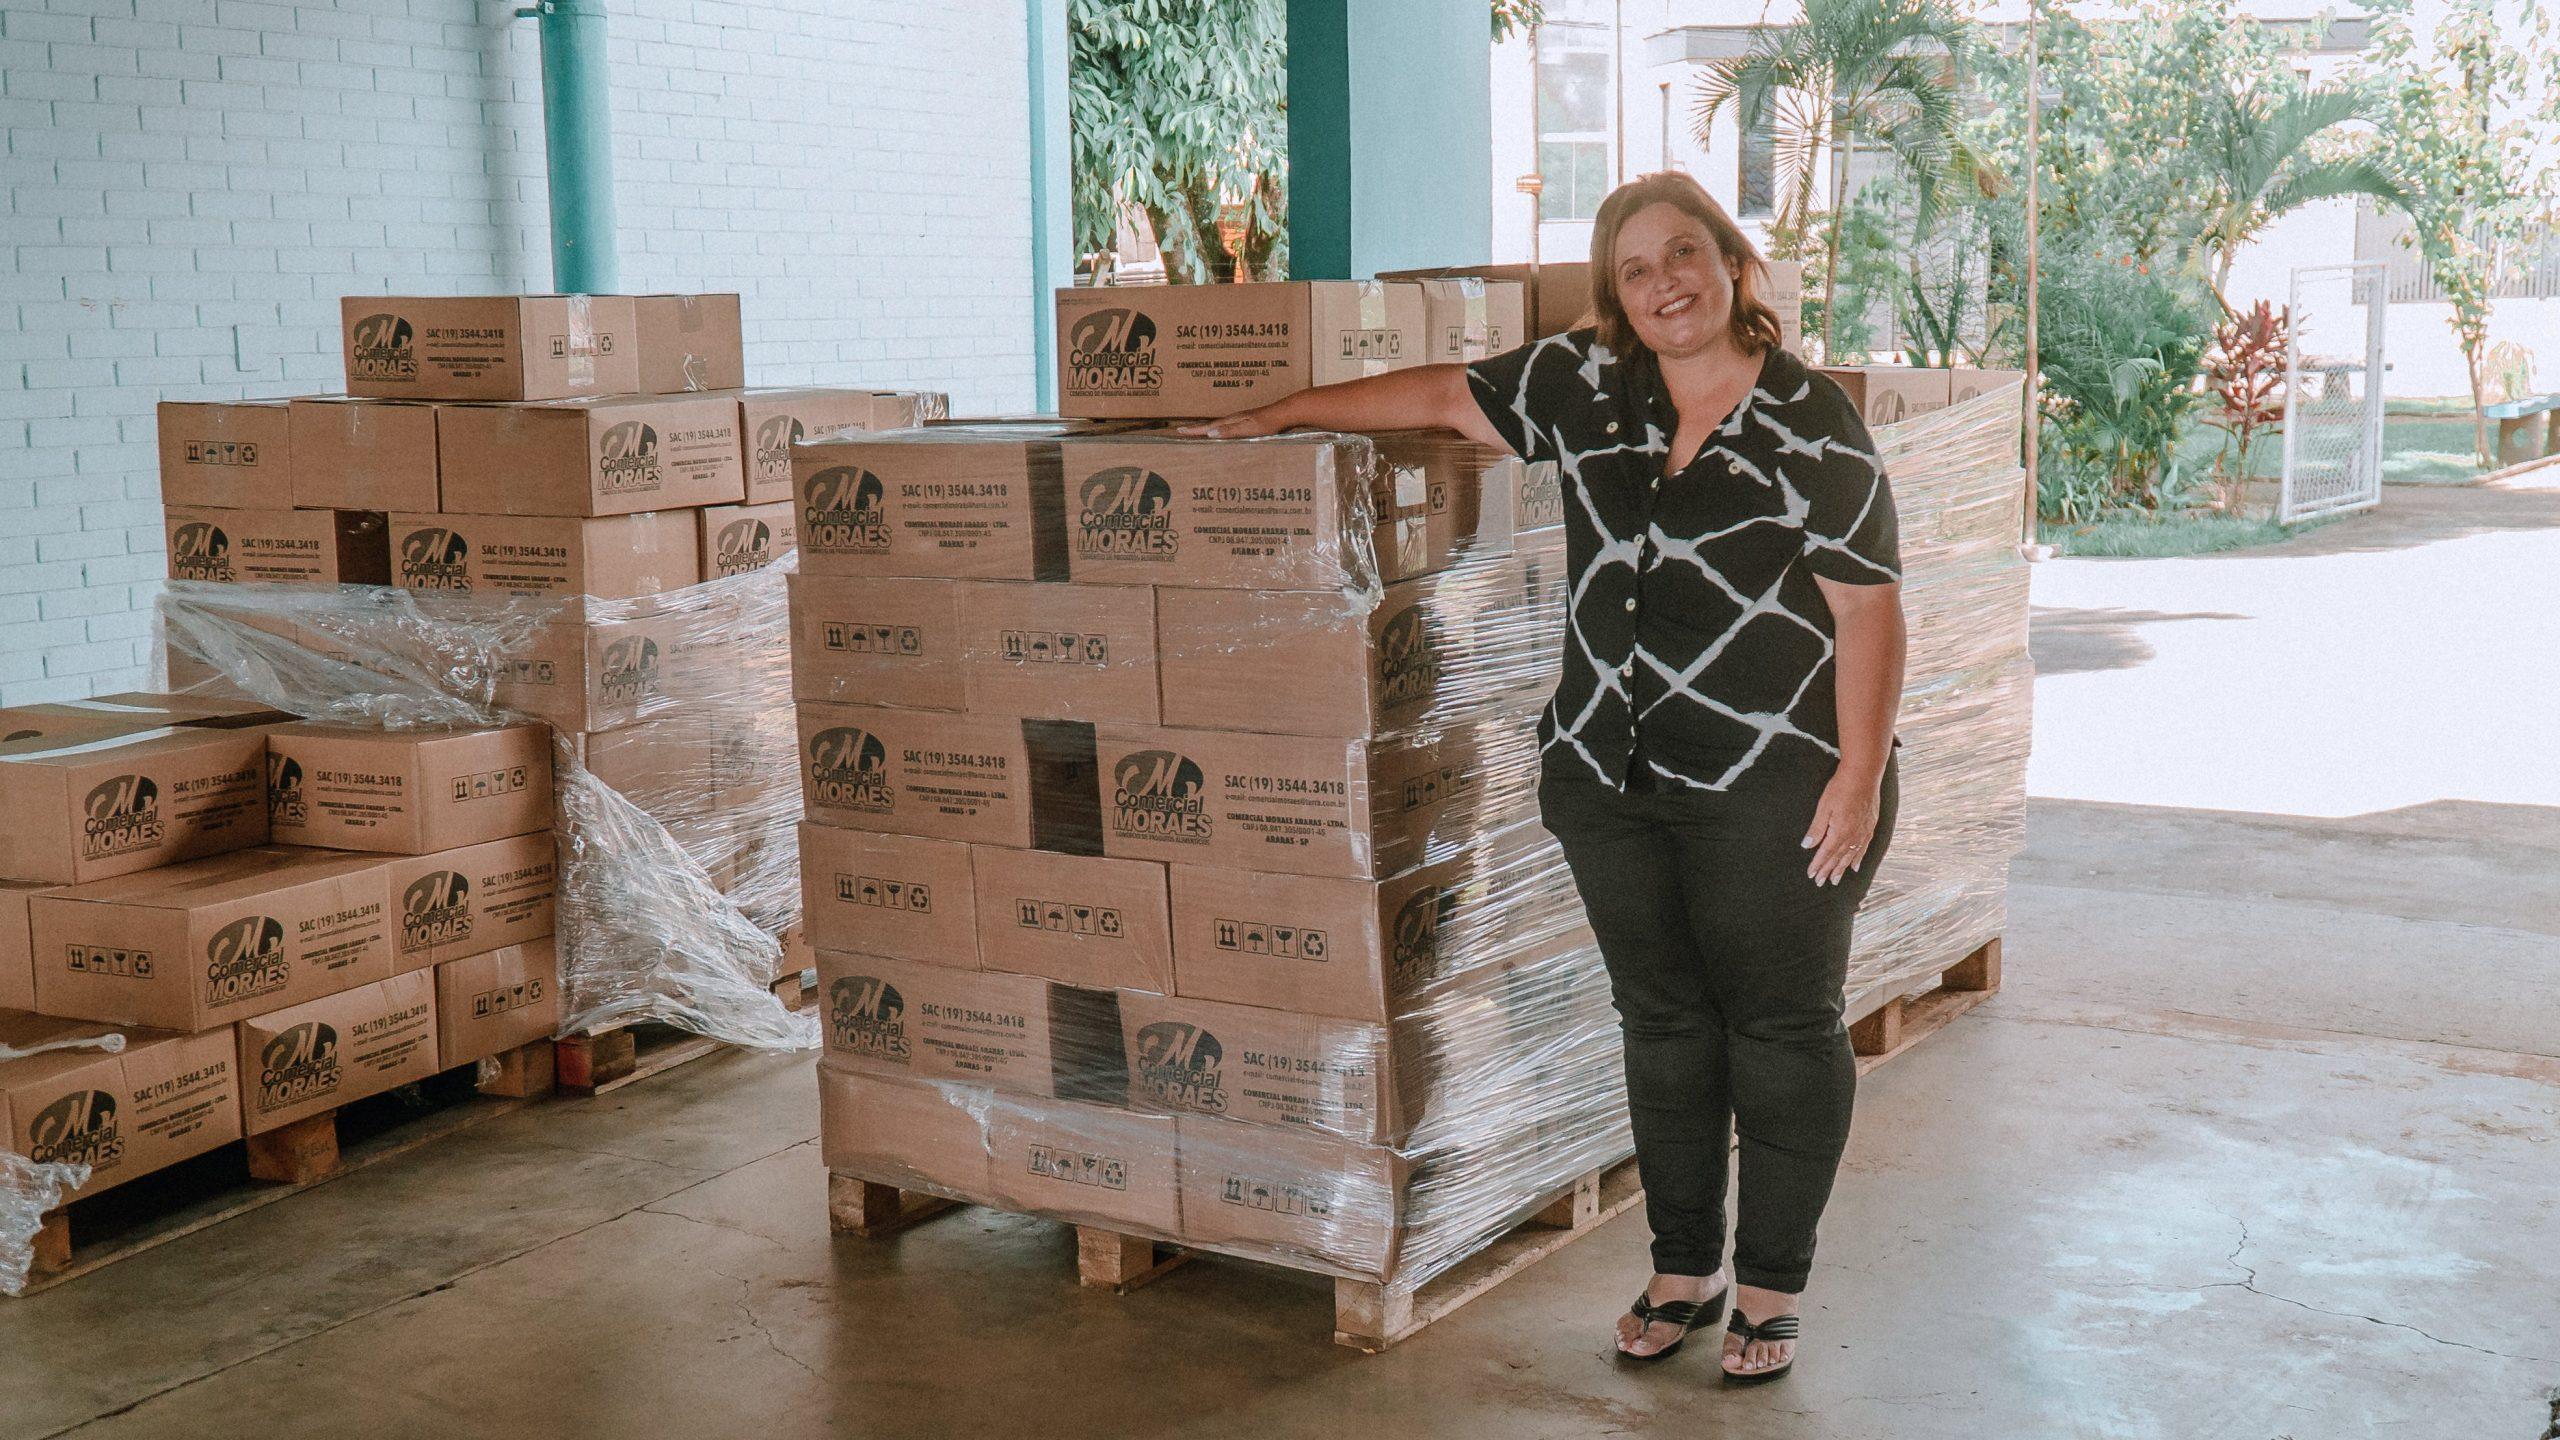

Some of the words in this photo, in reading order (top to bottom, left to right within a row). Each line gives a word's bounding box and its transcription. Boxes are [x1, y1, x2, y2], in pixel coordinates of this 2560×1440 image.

[426, 329, 440, 338] SAC
[443, 329, 458, 339] (19)
[460, 329, 503, 338] 3544.3418
[1176, 326, 1197, 338] SAC
[1200, 325, 1222, 339] (19)
[1226, 322, 1289, 336] 3544.3418
[353, 343, 412, 358] Comercial
[1070, 348, 1155, 366] Comercial
[351, 358, 418, 376] MORAES
[1067, 365, 1163, 390] MORAES
[669, 433, 681, 443] SAC
[683, 432, 696, 443] (19)
[698, 428, 731, 440] 3544.3418
[601, 451, 657, 471] Comercial
[599, 464, 662, 491] MORAES
[902, 485, 921, 497] SAC
[924, 485, 944, 498] (19)
[948, 483, 1007, 496] 3544.3418
[1192, 488, 1214, 500] SAC
[1217, 488, 1241, 503] (19)
[1245, 488, 1312, 501] 3544.3418
[805, 505, 883, 524] Comercial
[1080, 508, 1170, 529] Comercial
[242, 539, 255, 548] SAC
[257, 539, 273, 549] (19)
[275, 539, 318, 549] 3544.3418
[804, 524, 892, 547] MORAES
[1078, 527, 1179, 554] MORAES
[173, 551, 229, 567] Comercial
[482, 545, 497, 555] SAC
[500, 546, 516, 557] (19)
[519, 547, 566, 557] 3544.3418
[717, 546, 770, 566] Comercial
[172, 565, 236, 582] MORAES
[402, 558, 467, 575] Comercial
[400, 573, 473, 594] MORAES
[903, 750, 921, 762] SAC
[924, 752, 944, 766] (19)
[948, 753, 1005, 768] 3544.3418
[317, 771, 332, 782] SAC
[335, 772, 351, 784] (19)
[354, 774, 401, 786] 3544.3418
[812, 761, 886, 785] Comercial
[174, 781, 189, 794] SAC
[192, 777, 208, 791] (19)
[811, 779, 894, 808] MORAES
[1225, 775, 1246, 788] SAC
[1250, 777, 1273, 792] (19)
[1278, 779, 1344, 795] 3544.3418
[1115, 787, 1203, 813] Comercial
[85, 805, 157, 834] Comercial
[1113, 806, 1212, 838] MORAES
[1227, 813, 1264, 822] COMERCIAL
[1266, 816, 1292, 824] MORAES
[83, 819, 164, 856] MORAES
[482, 876, 496, 888] SAC
[498, 872, 512, 886] (19)
[299, 919, 315, 933] SAC
[318, 914, 334, 930] (19)
[337, 903, 380, 923] 3544.3418
[403, 899, 468, 929] Comercial
[401, 912, 474, 951] MORAES
[208, 946, 283, 981] Comercial
[206, 960, 290, 1005] MORAES
[353, 1023, 368, 1037] SAC
[370, 1018, 385, 1033] (19)
[388, 1005, 428, 1026] 3544.3418
[831, 1007, 904, 1036] Comercial
[922, 1003, 940, 1016] SAC
[943, 1006, 963, 1022] (19)
[966, 1010, 1024, 1029] 3544.3418
[830, 1024, 911, 1058] MORAES
[261, 1050, 336, 1089] Comercial
[1243, 1051, 1265, 1066] SAC
[1268, 1054, 1292, 1071] (19)
[134, 1086, 152, 1103] SAC
[155, 1079, 174, 1098] (19)
[177, 1061, 226, 1089] 3544.3418
[258, 1063, 342, 1112] MORAES
[31, 1119, 116, 1166] Comercial
